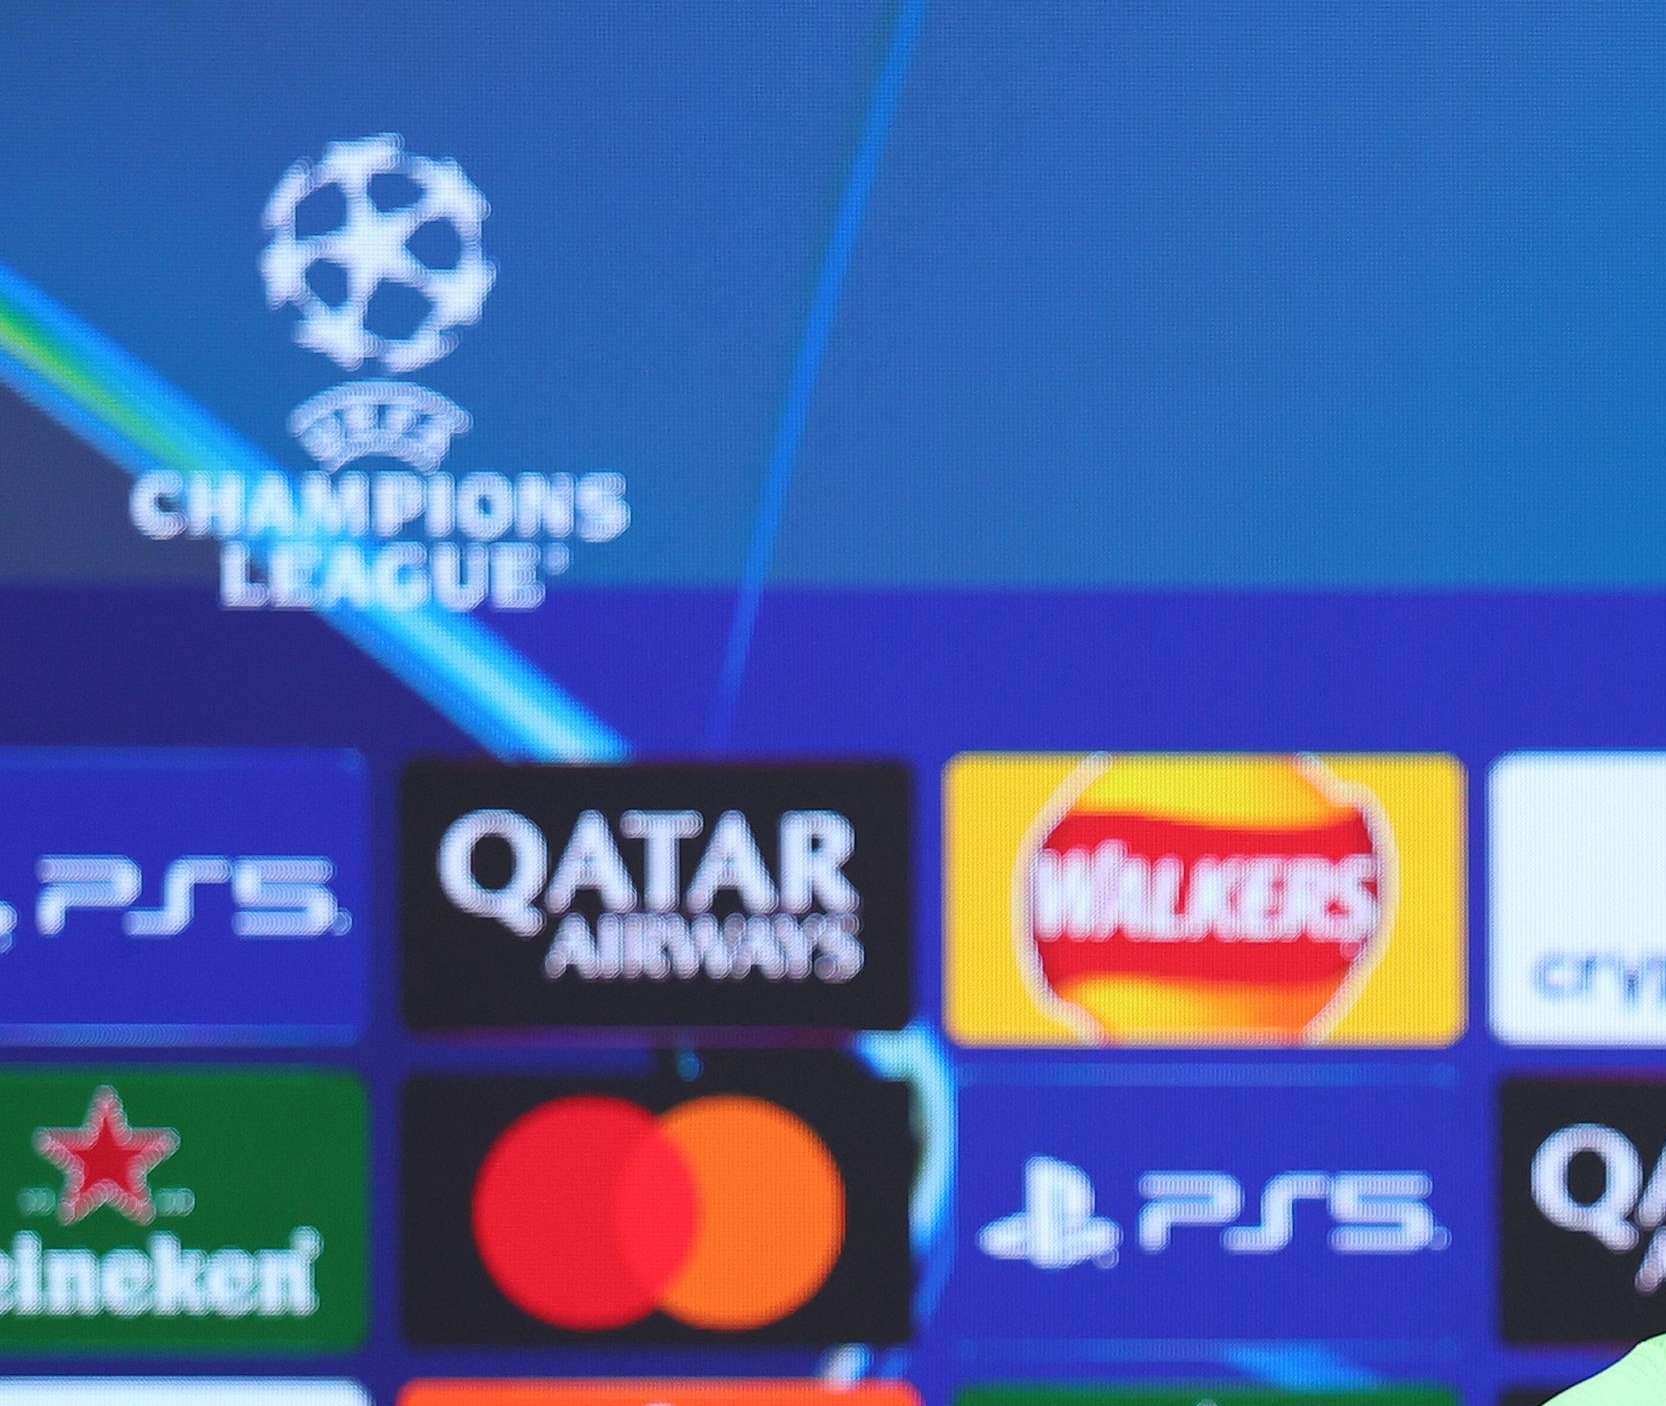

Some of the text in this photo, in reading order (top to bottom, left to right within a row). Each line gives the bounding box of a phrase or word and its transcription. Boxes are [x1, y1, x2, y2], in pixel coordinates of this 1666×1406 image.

[130, 470, 630, 541] CHAMPIONS
[220, 541, 546, 611] LEAGUE
[36, 855, 342, 937] PS5
[437, 808, 861, 938] QATAR
[1031, 840, 1380, 943] WALKERS
[544, 912, 866, 982] AIRWAYS
[1137, 1169, 1436, 1254] PS5
